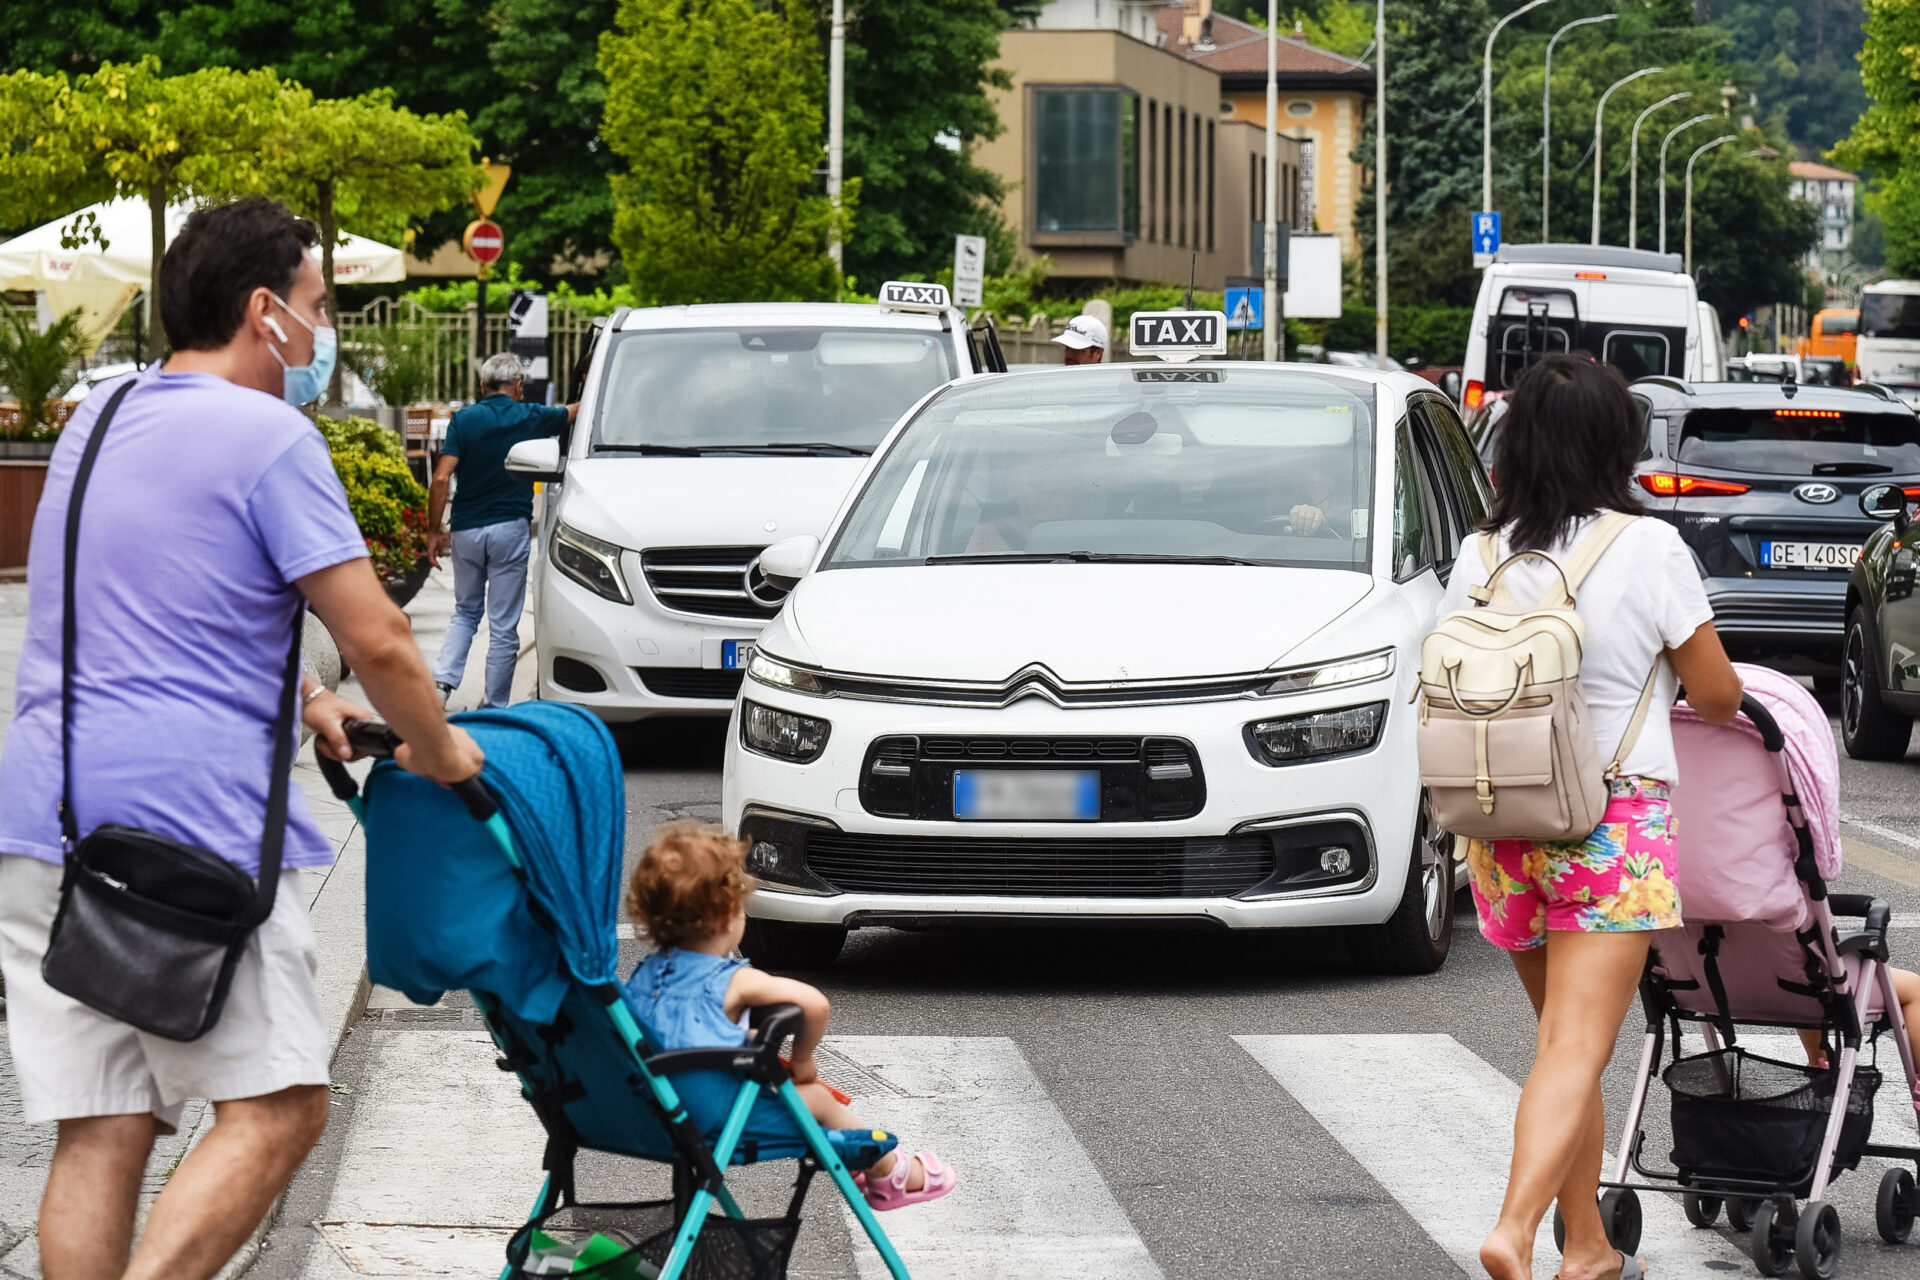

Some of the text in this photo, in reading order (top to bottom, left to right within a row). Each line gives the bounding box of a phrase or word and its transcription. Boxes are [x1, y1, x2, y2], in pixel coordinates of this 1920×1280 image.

[887, 286, 941, 304] TAXI
[1137, 318, 1213, 343] TAXI
[1773, 544, 1795, 563] GE
